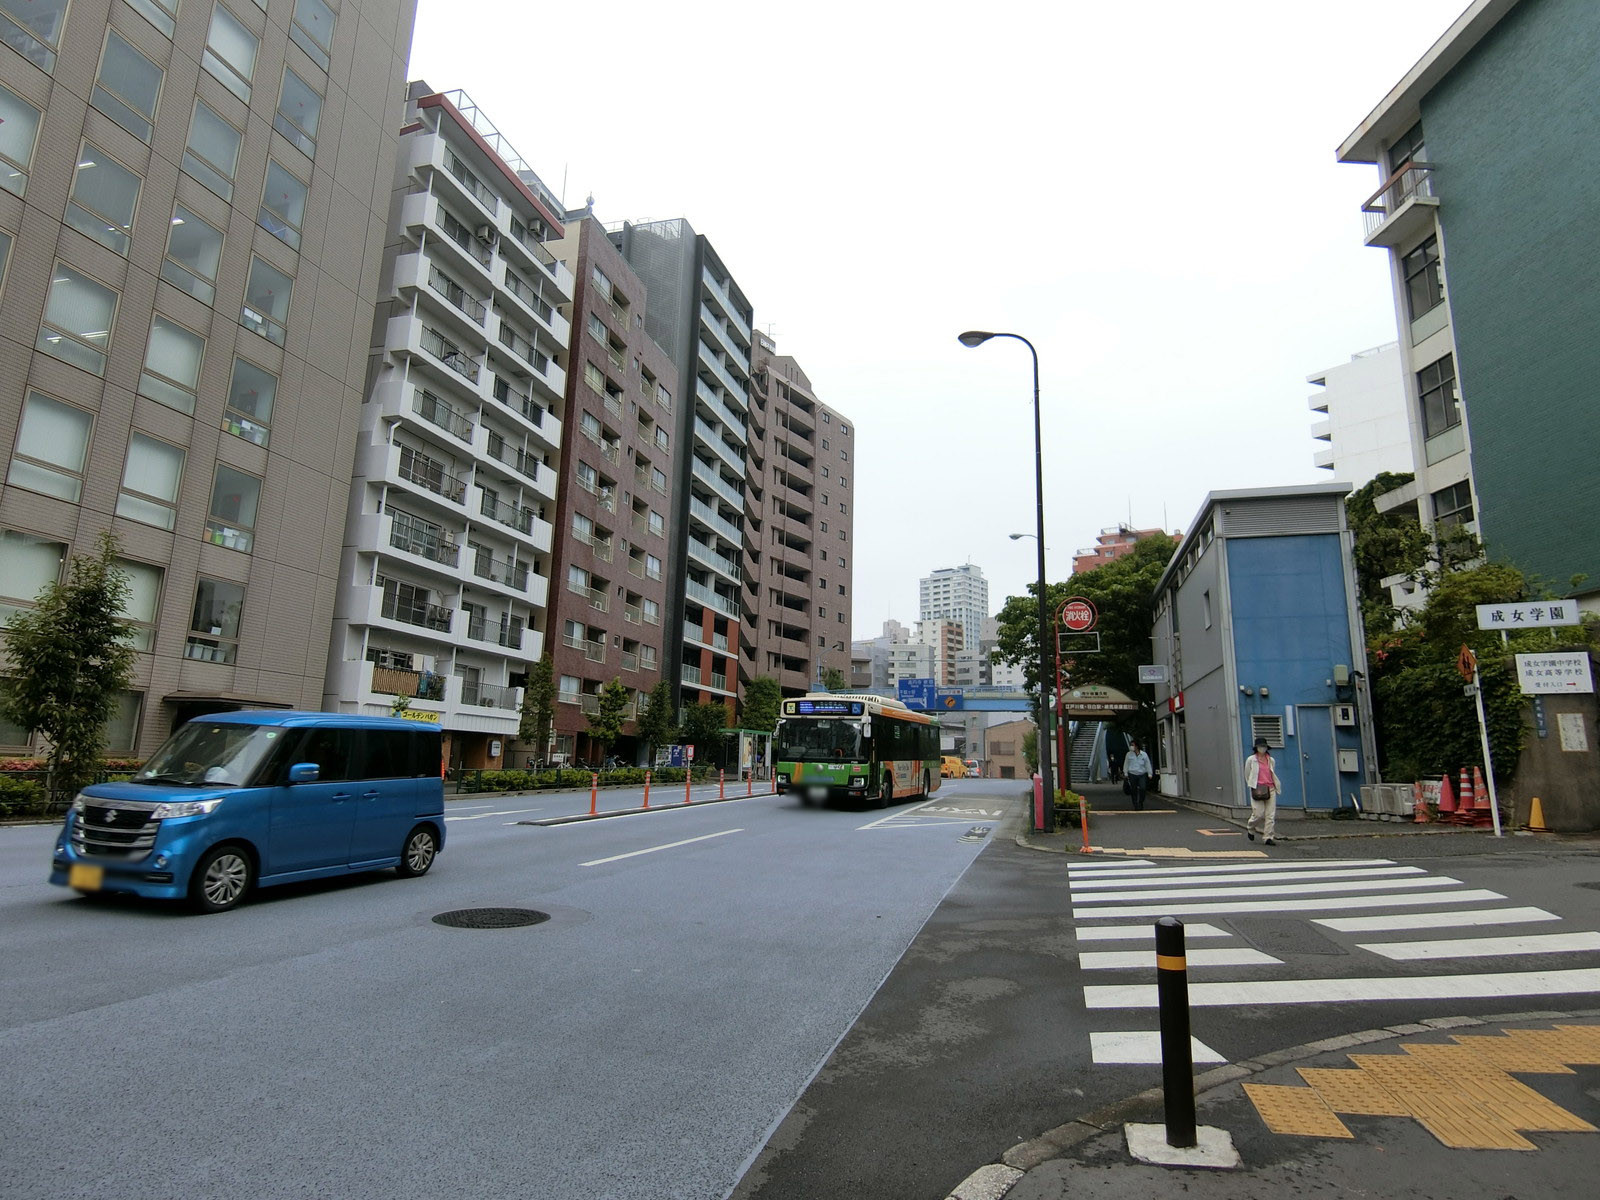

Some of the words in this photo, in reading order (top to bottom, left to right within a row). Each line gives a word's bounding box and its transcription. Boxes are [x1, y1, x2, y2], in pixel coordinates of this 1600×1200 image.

[1065, 610, 1090, 621] 消火栓
[1491, 606, 1565, 623] 成女学園
[1524, 659, 1582, 667] 成女学園中学校
[1525, 668, 1583, 677] 成女高等学校
